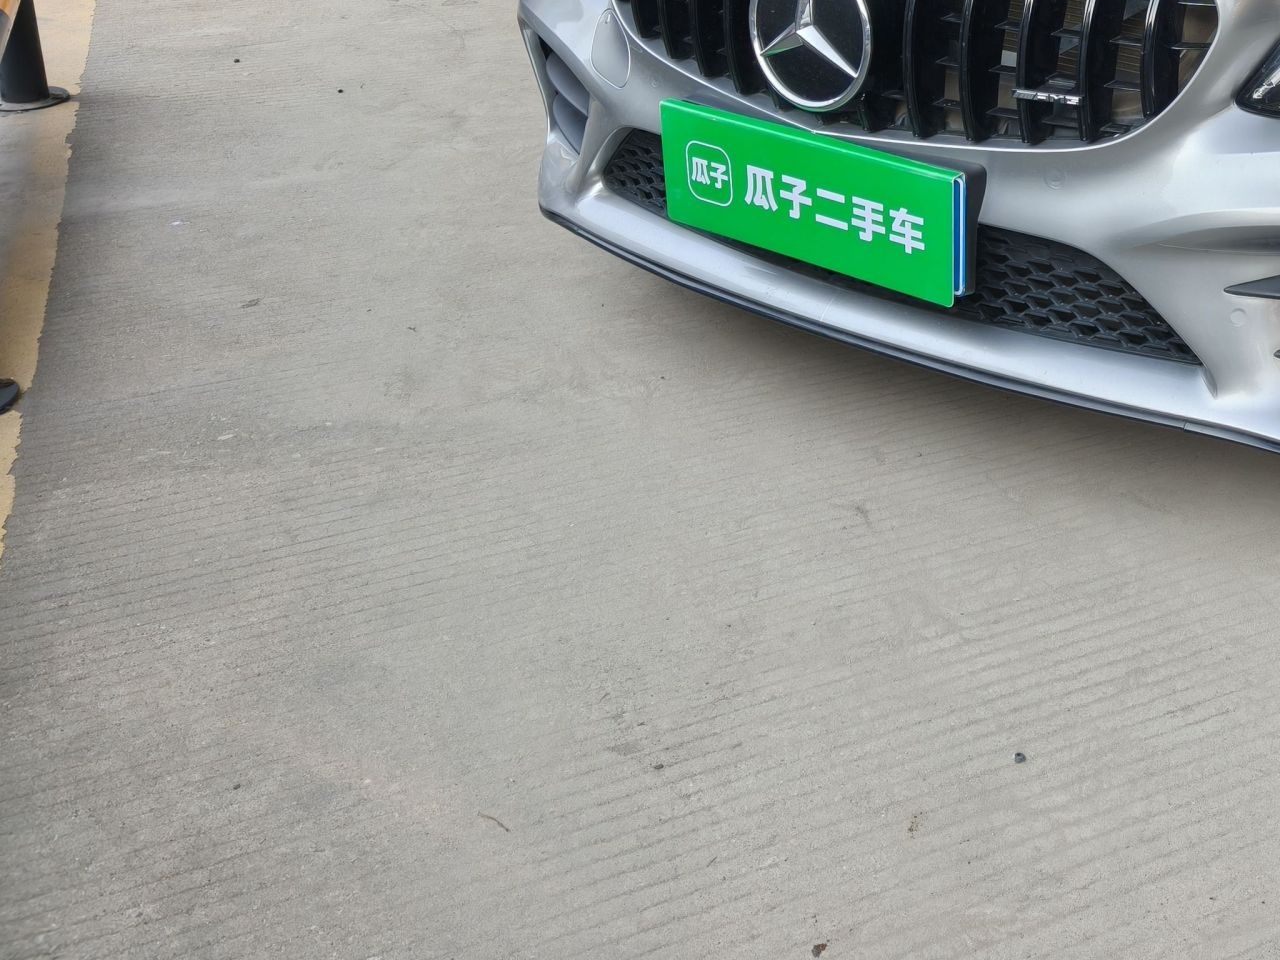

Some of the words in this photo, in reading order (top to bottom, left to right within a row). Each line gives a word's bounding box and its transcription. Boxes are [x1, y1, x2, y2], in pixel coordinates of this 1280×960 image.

[692, 157, 728, 189] 瓜子
[744, 165, 925, 254] 瓜子二手车
